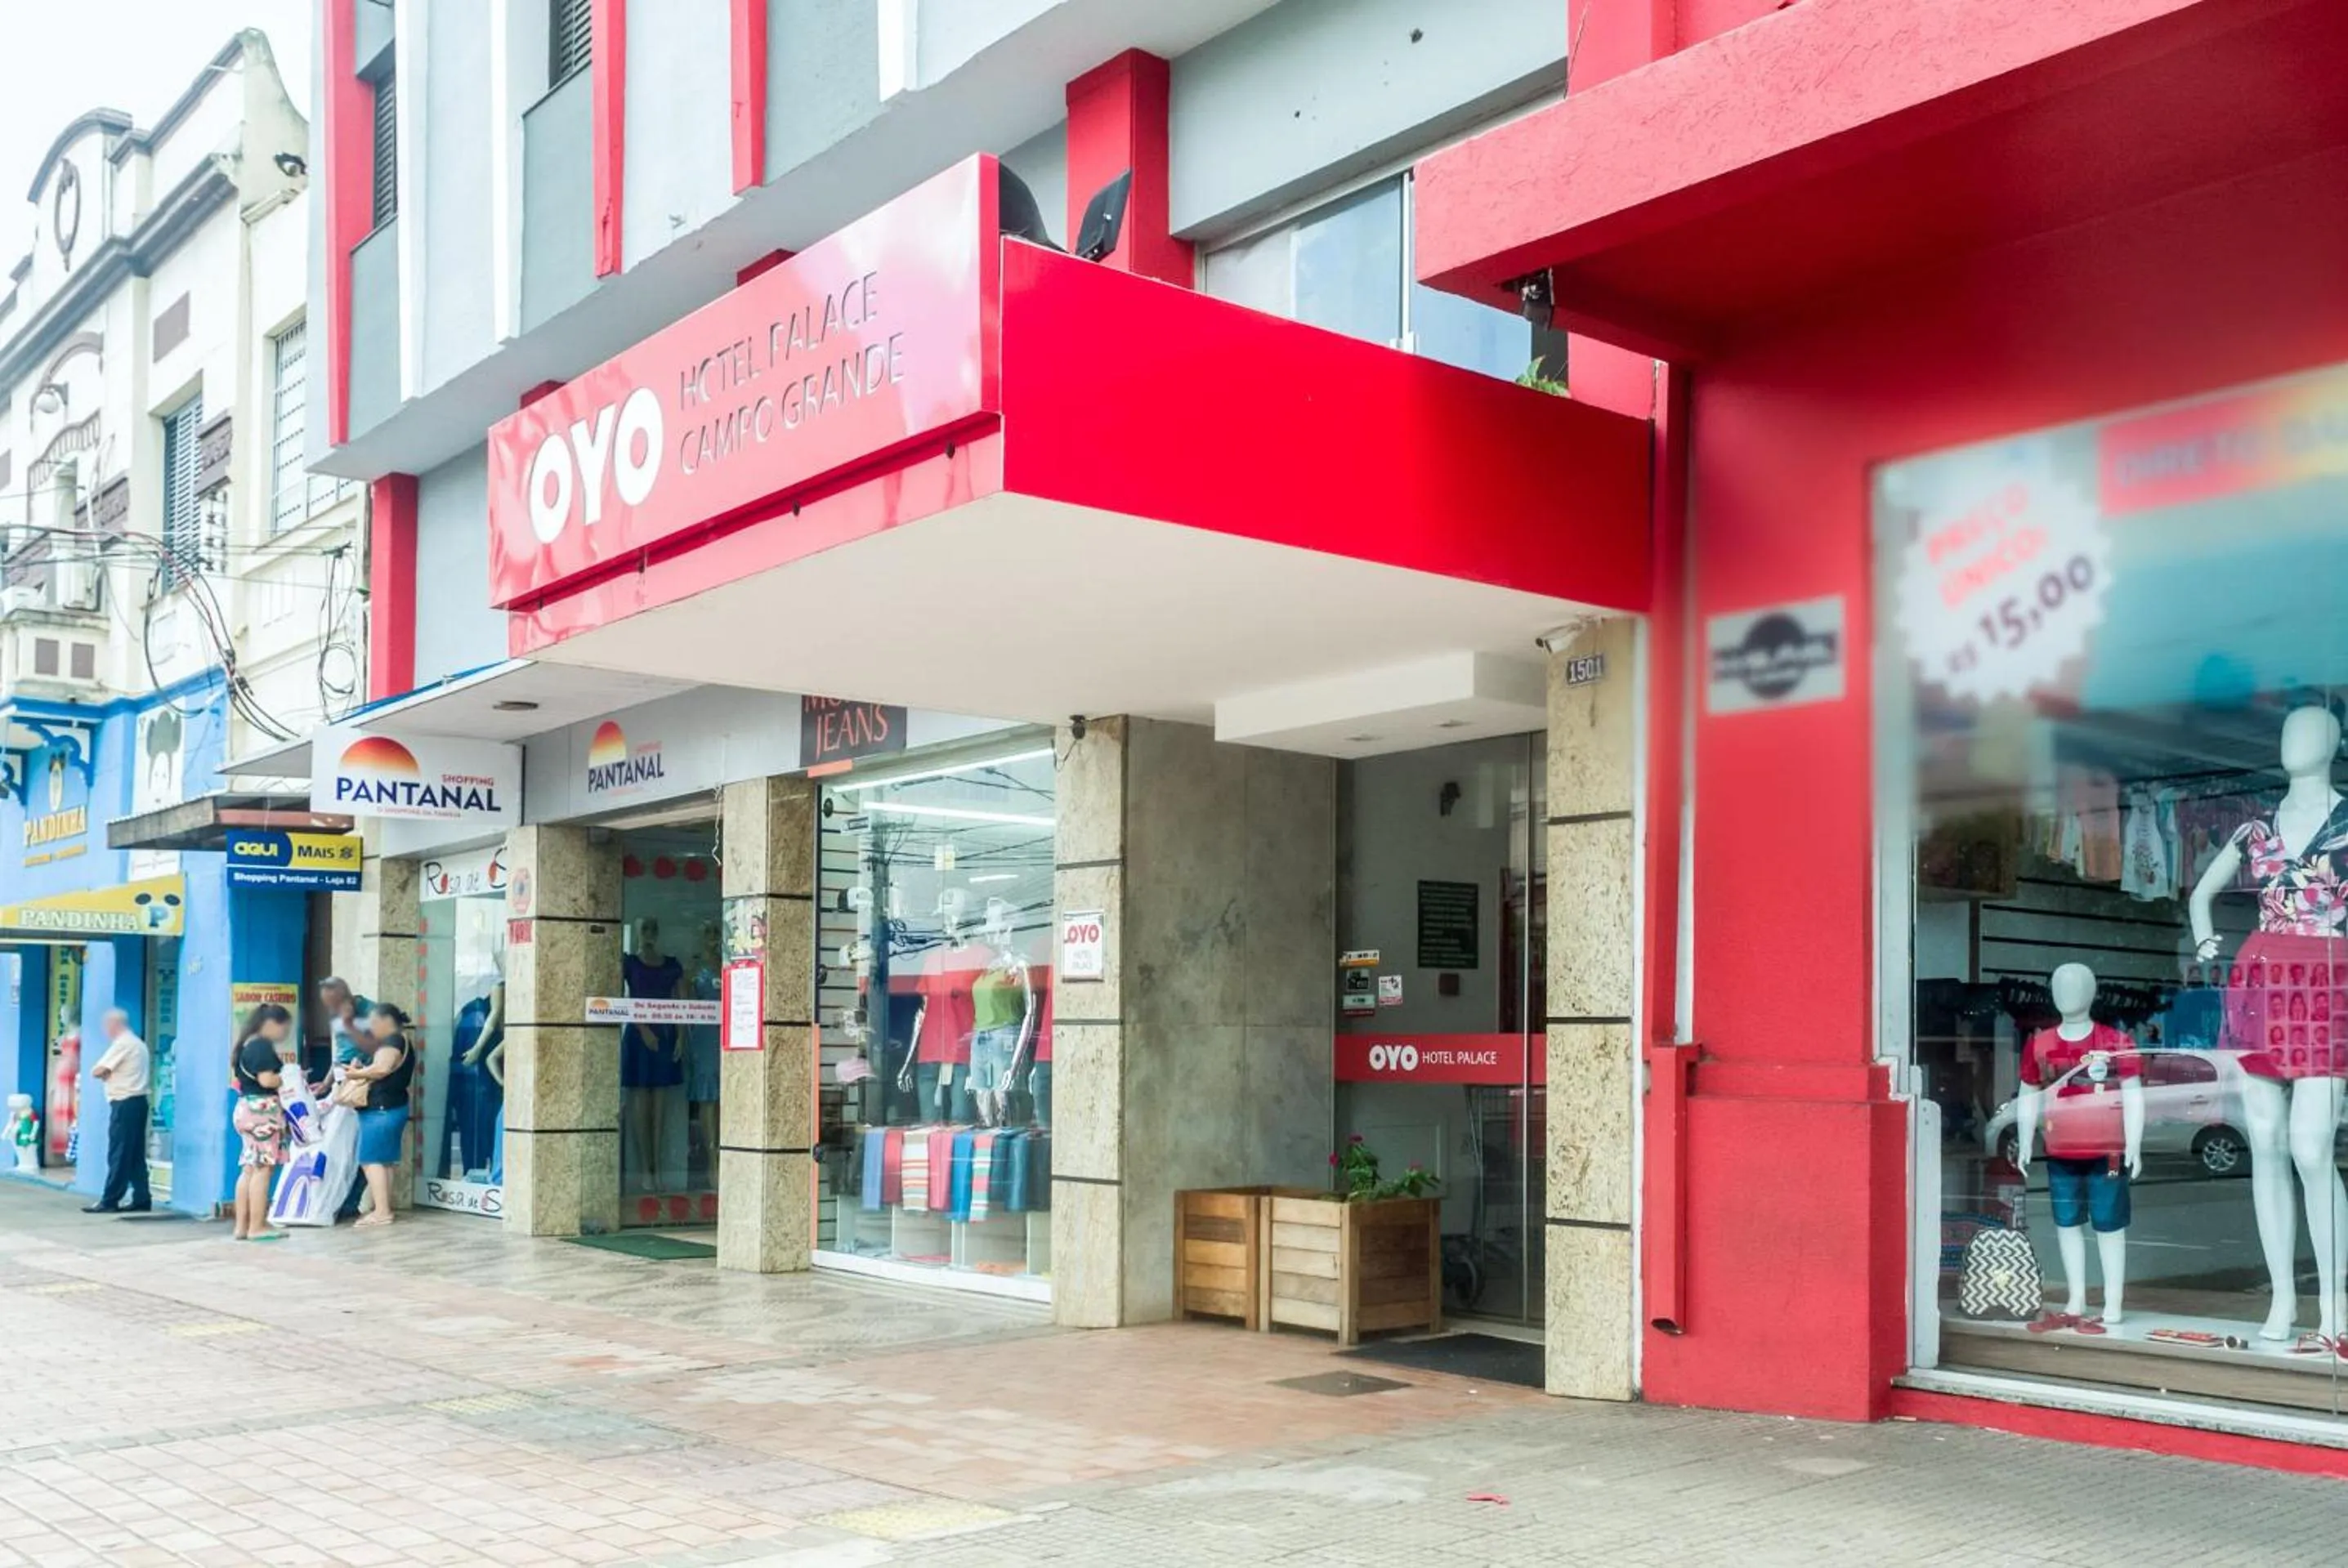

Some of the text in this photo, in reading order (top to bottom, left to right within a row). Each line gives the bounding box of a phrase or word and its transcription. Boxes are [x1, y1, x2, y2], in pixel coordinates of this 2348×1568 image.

[679, 270, 878, 411] HOTEL PALACE
[679, 333, 905, 477] CAMPO GRANDE
[528, 386, 664, 544] OYO
[1979, 553, 2095, 650] 15,00
[1569, 657, 1602, 681] 1501
[816, 704, 889, 761] JEANS
[441, 774, 494, 787] SHOPPING
[588, 753, 664, 793] PANTANAL
[336, 777, 502, 812] PANTANAL
[24, 805, 87, 847] PANDINHA
[234, 872, 278, 884] Shopping
[280, 874, 318, 883] Pantanal
[325, 876, 345, 886] Loja
[20, 909, 139, 931] PANDINHA
[1067, 924, 1099, 944] OYO
[588, 1008, 628, 1016] PANTANAL
[1369, 1045, 1497, 1071] OYO HOTEL PALACE
